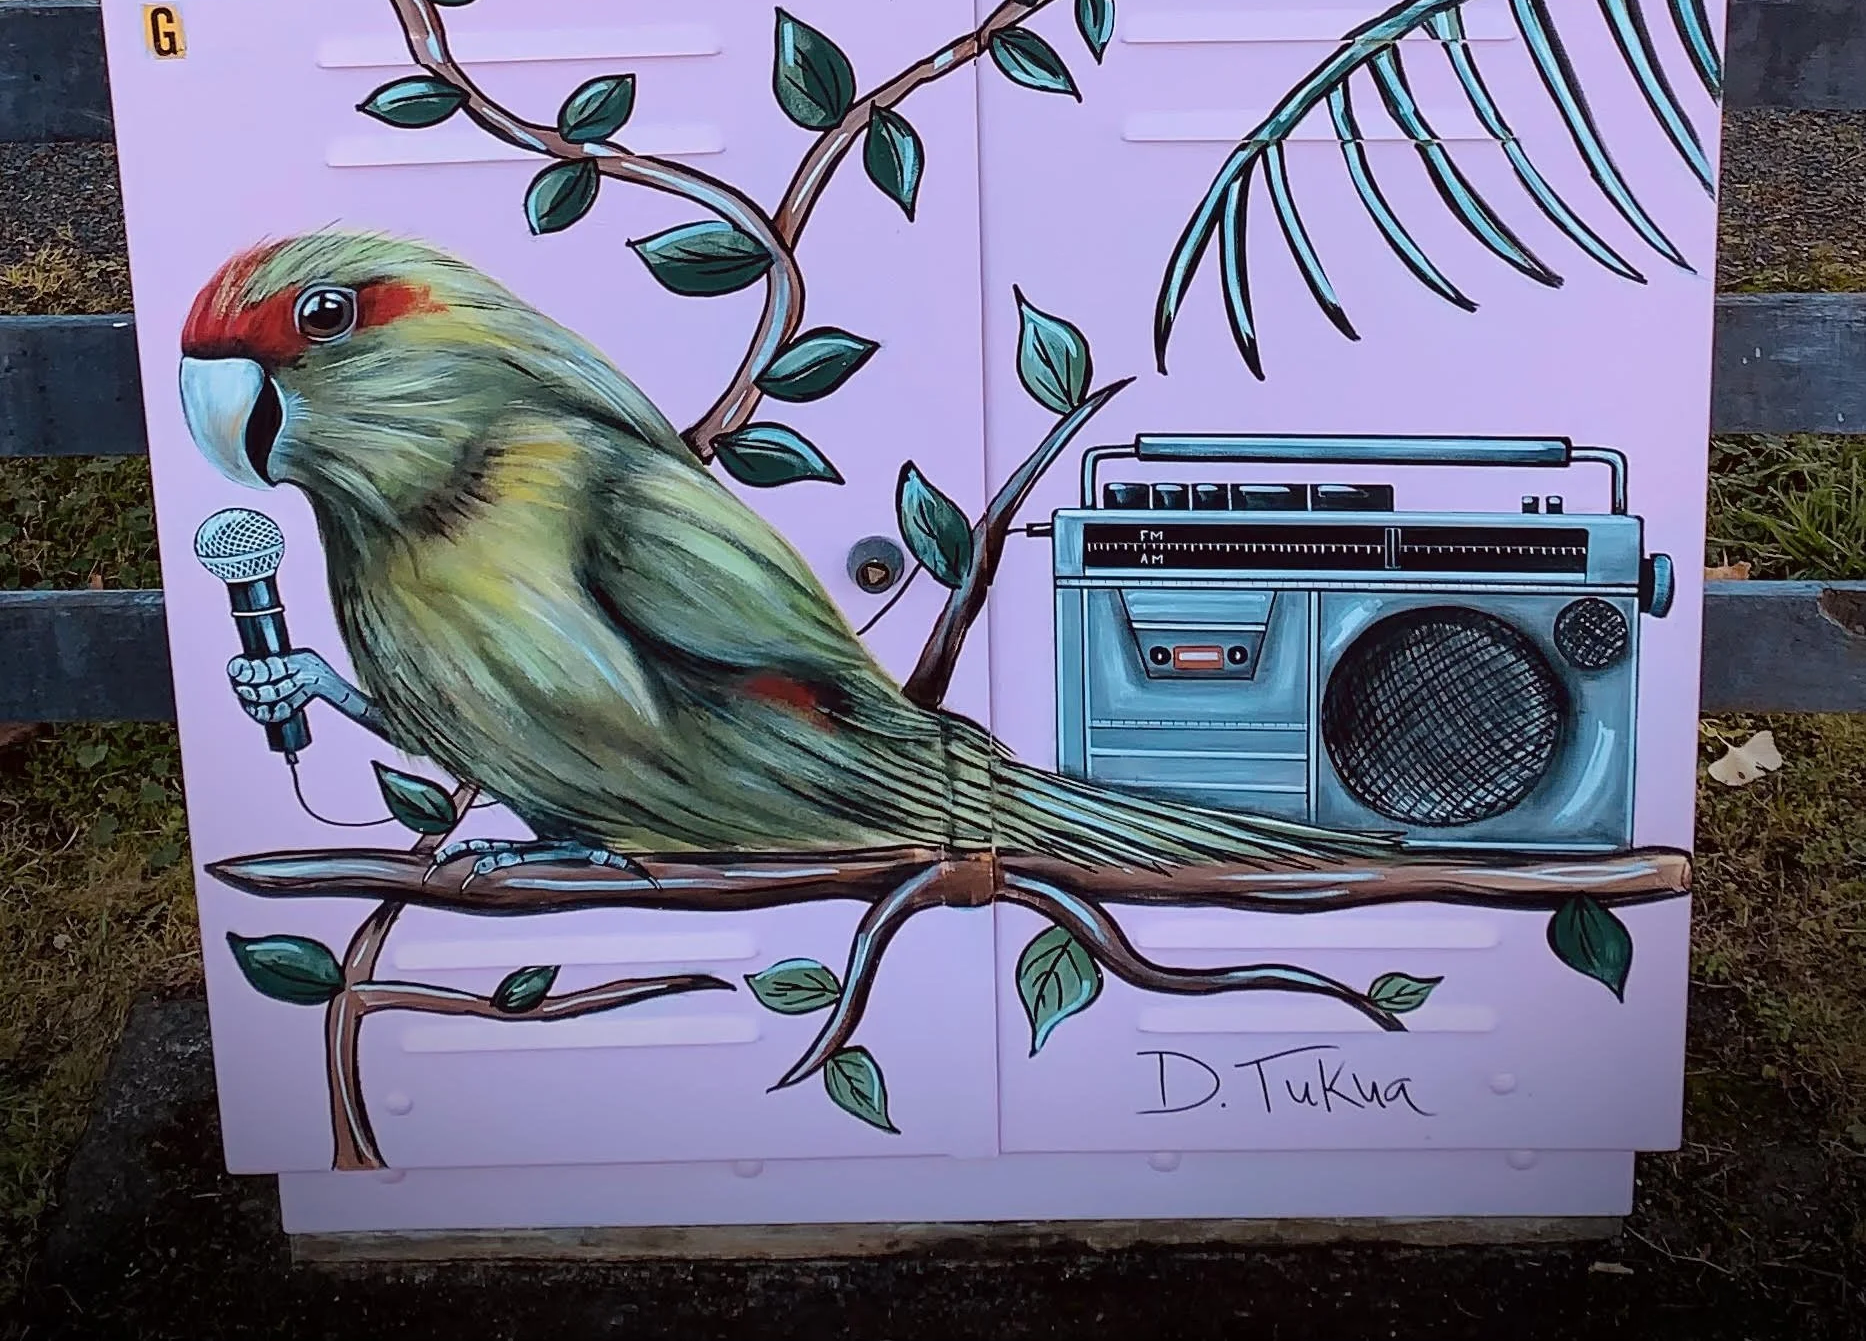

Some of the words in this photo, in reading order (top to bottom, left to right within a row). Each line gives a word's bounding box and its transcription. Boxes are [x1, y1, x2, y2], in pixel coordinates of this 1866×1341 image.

[150, 6, 179, 57] G
[1140, 529, 1164, 542] FM
[1140, 553, 1164, 565] AM
[1136, 1050, 1227, 1115] D.
